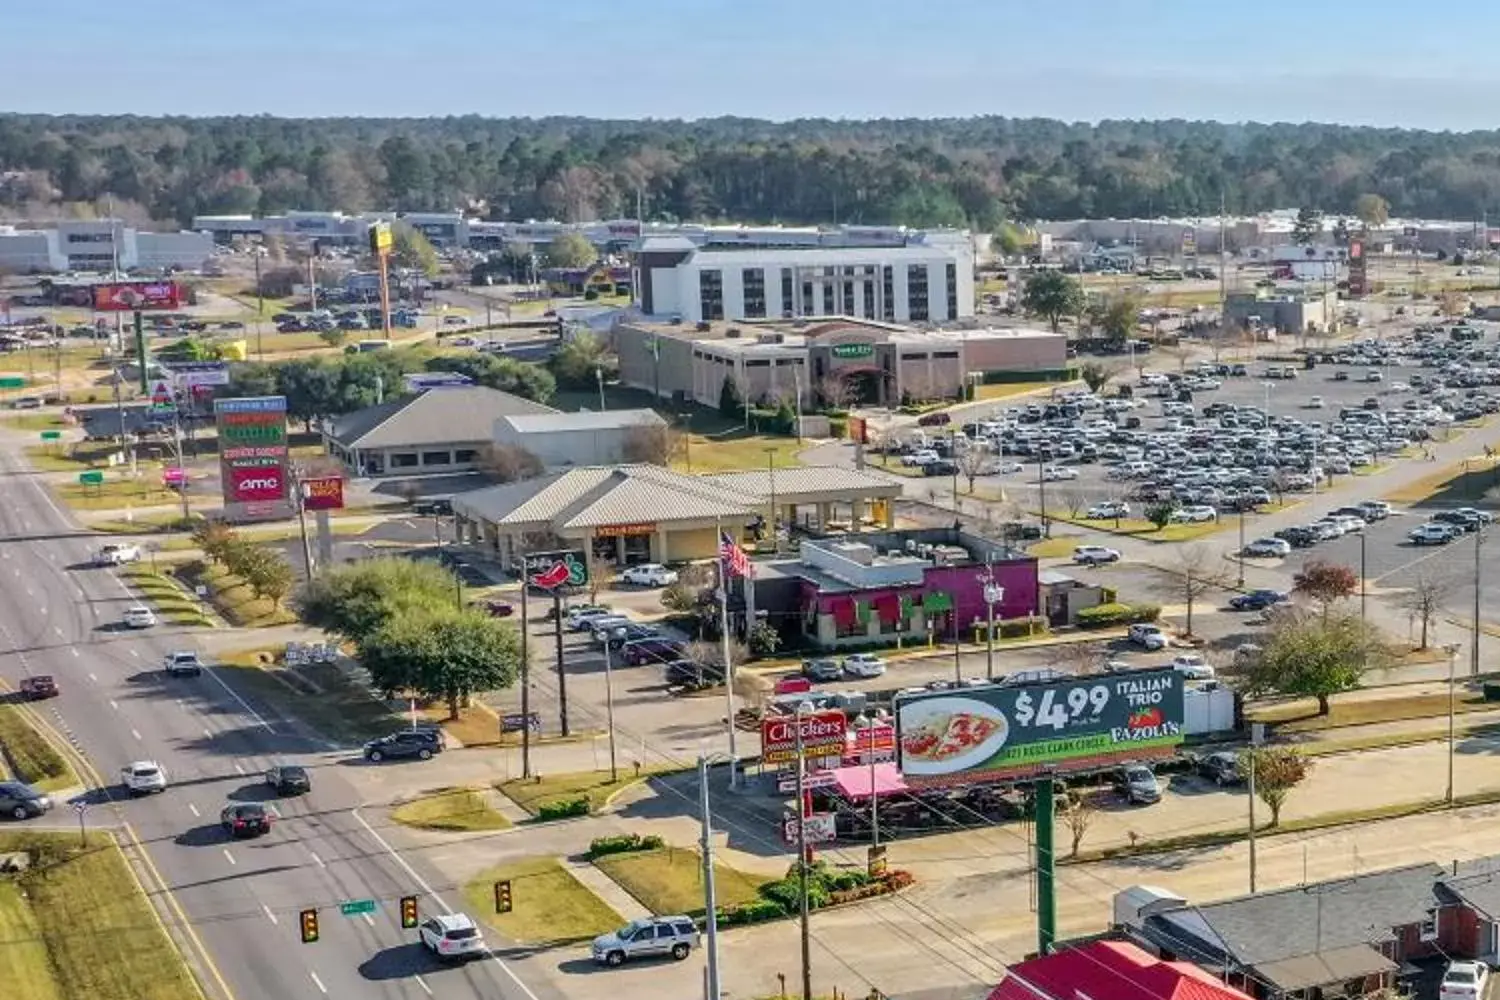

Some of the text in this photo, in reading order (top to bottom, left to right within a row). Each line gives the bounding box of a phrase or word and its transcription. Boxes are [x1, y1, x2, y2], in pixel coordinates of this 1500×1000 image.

[1117, 676, 1172, 695] ITALIAN
[1127, 691, 1163, 707] TRIO
[769, 717, 841, 741] Chckers
[1047, 741, 1074, 754] CLARK
